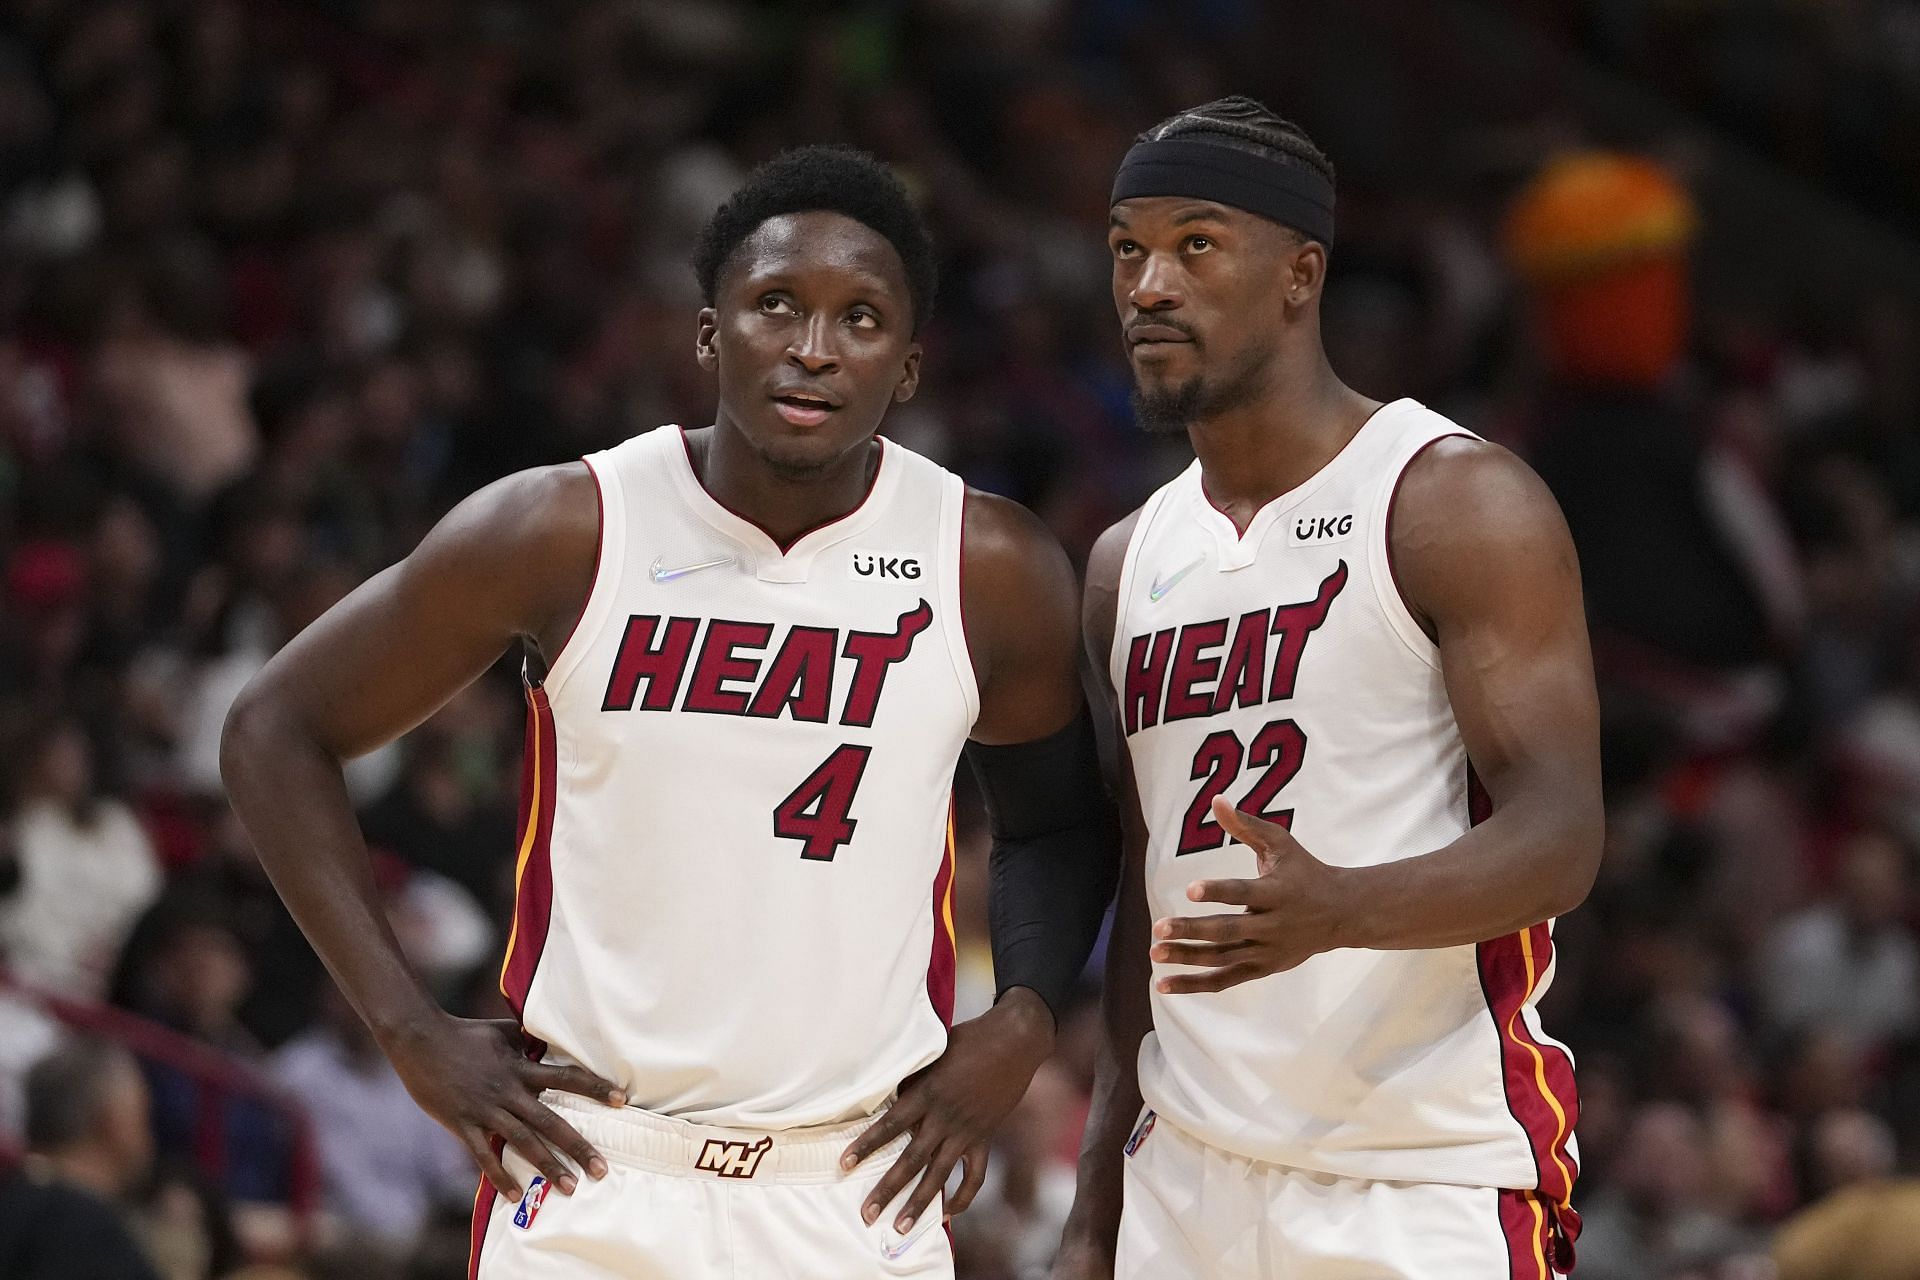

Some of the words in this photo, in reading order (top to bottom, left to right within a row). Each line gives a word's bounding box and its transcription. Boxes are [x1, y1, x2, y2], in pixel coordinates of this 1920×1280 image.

[601, 597, 933, 728] HEAT
[1125, 558, 1348, 737] HEAT
[772, 743, 873, 862] 4
[1176, 718, 1307, 857] 22
[695, 1135, 773, 1178] MH
